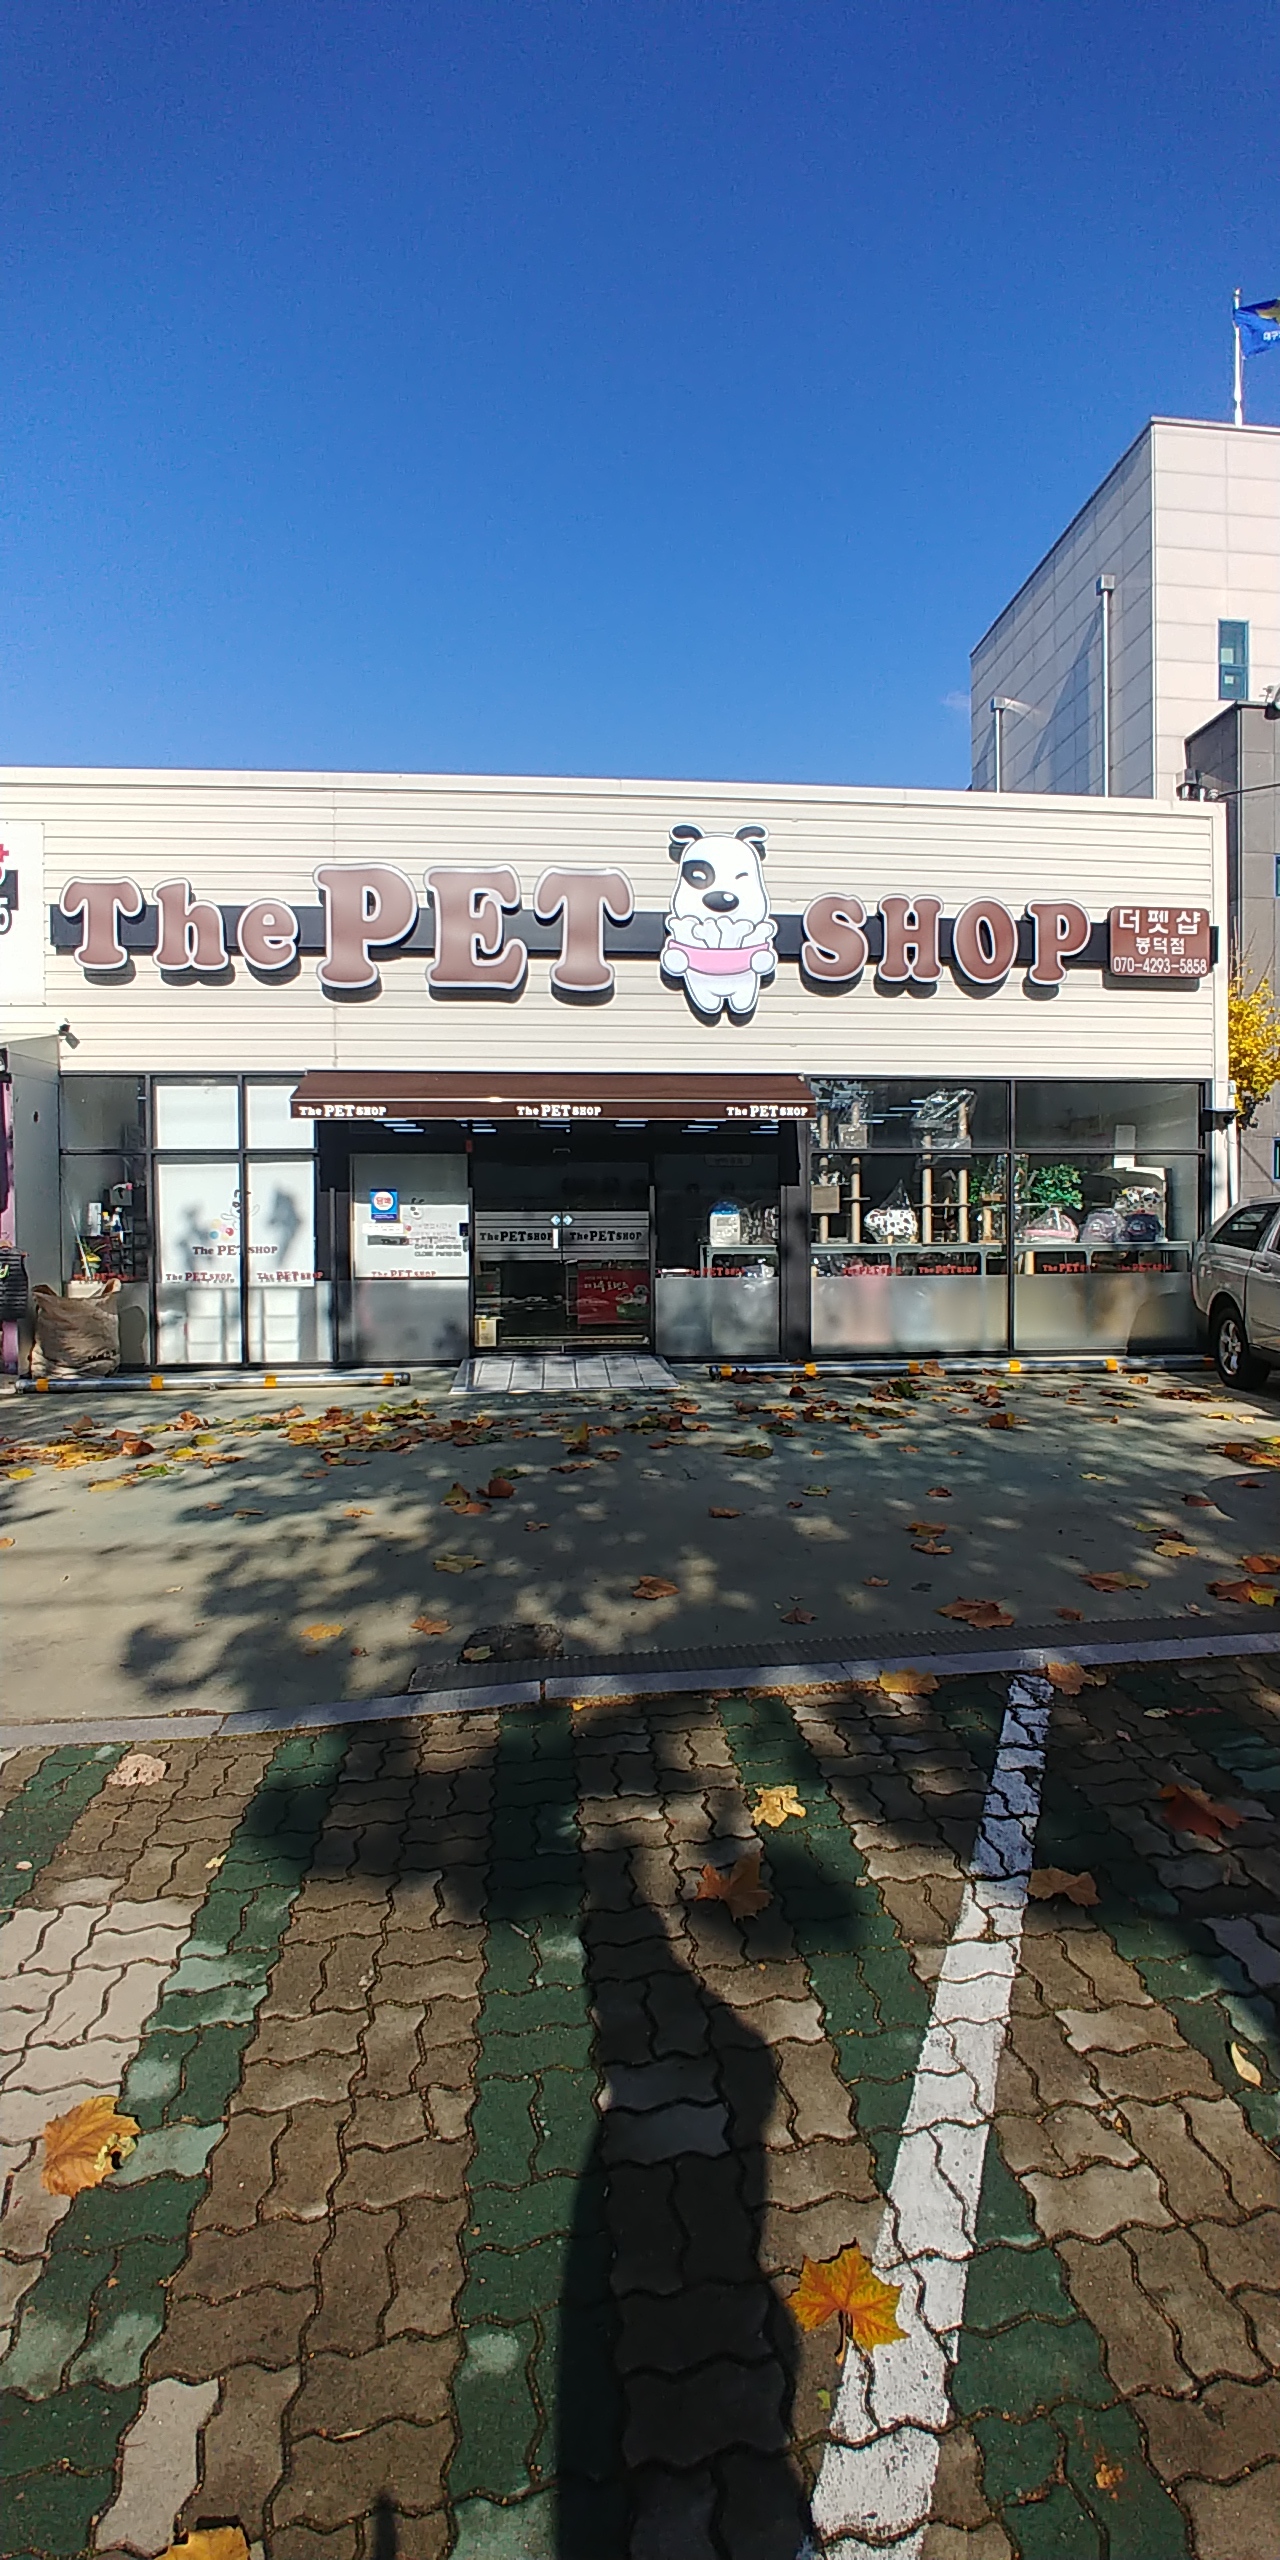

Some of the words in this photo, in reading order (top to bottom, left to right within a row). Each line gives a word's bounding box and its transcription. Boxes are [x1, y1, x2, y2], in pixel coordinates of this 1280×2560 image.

[59, 876, 300, 970] The
[313, 862, 635, 992] PET
[801, 892, 1092, 985] SHOP
[1136, 937, 1184, 955] 봉덕점
[1113, 956, 1207, 974] 070-4293-5858
[299, 1106, 322, 1116] The
[323, 1104, 355, 1117] PET
[355, 1106, 387, 1116] SHOP
[516, 1105, 539, 1116] The
[540, 1104, 571, 1117] PET
[572, 1106, 601, 1116] SHOP
[726, 1106, 748, 1116] The
[749, 1104, 778, 1117] PET
[779, 1106, 808, 1116] SHOP
[500, 1230, 527, 1242] PET
[569, 1231, 589, 1241] The
[589, 1230, 618, 1242] PET
[618, 1231, 643, 1241] SHOP
[192, 1246, 214, 1255] The
